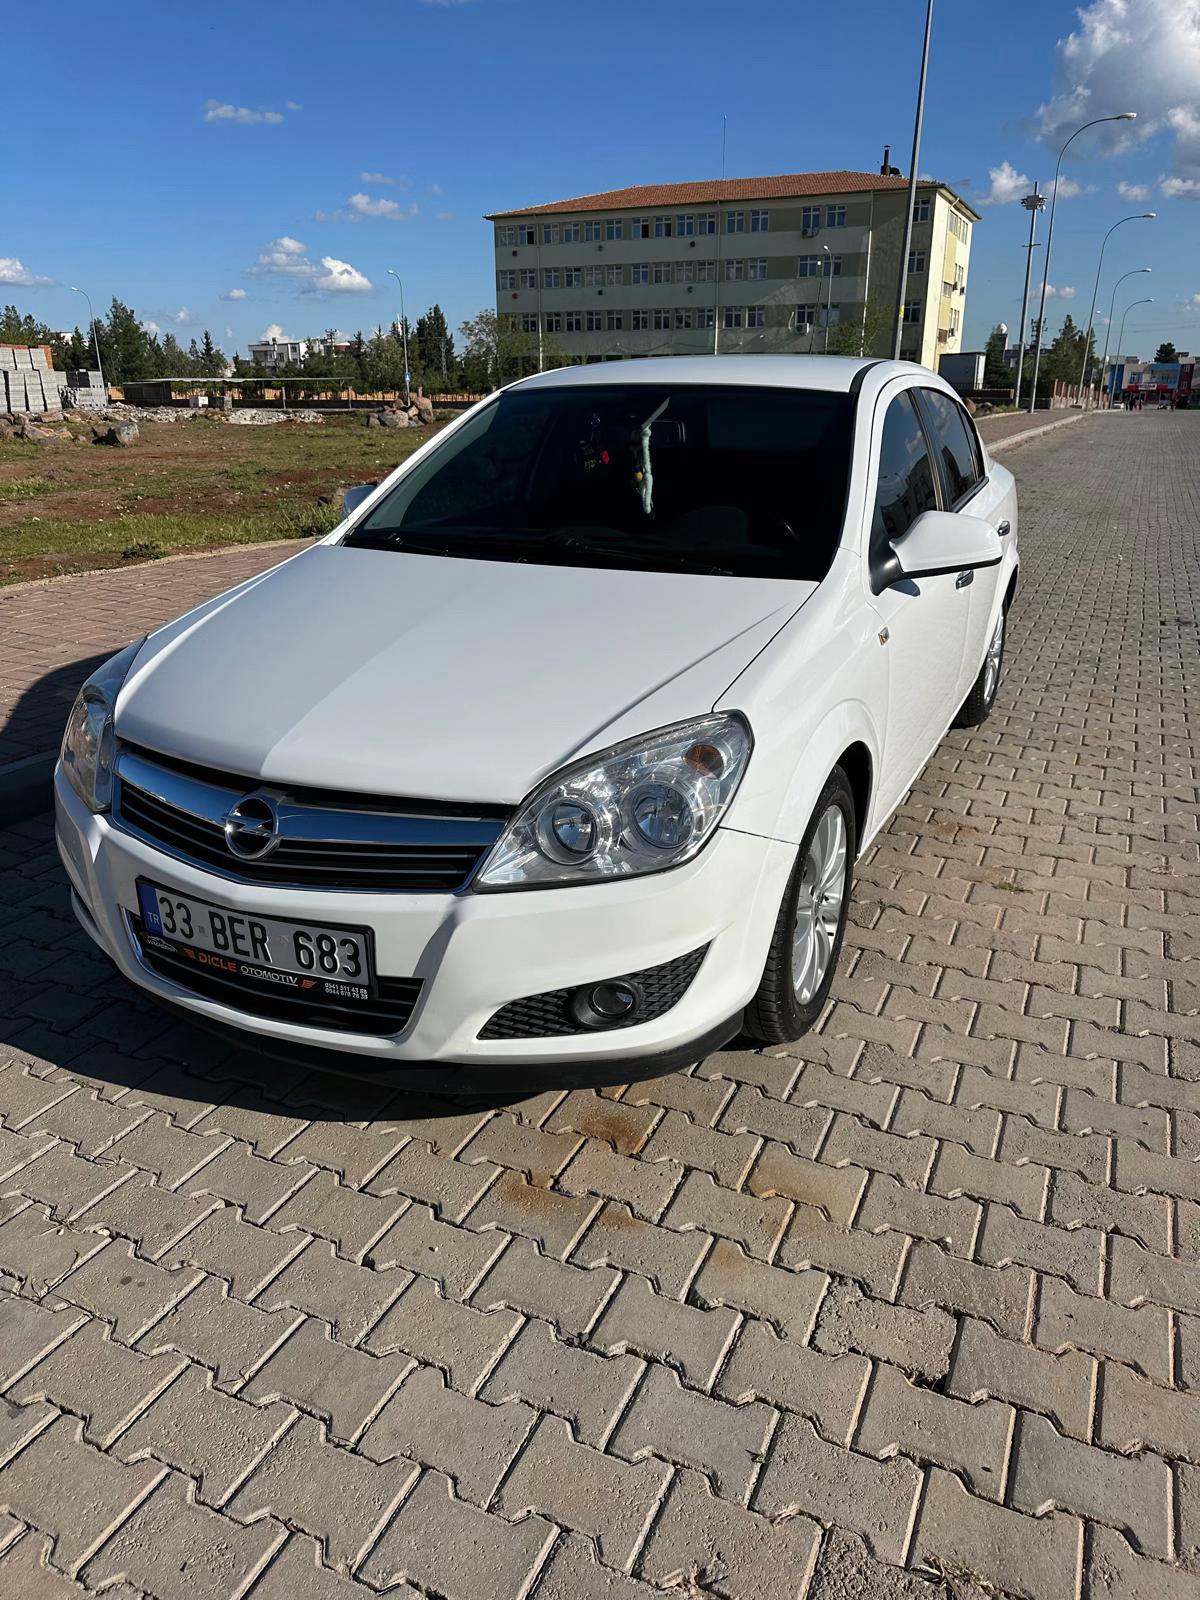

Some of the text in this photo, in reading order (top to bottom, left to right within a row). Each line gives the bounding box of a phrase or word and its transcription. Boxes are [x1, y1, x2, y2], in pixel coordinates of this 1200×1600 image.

[147, 912, 160, 925] TR
[159, 897, 362, 978] 33 BER 683
